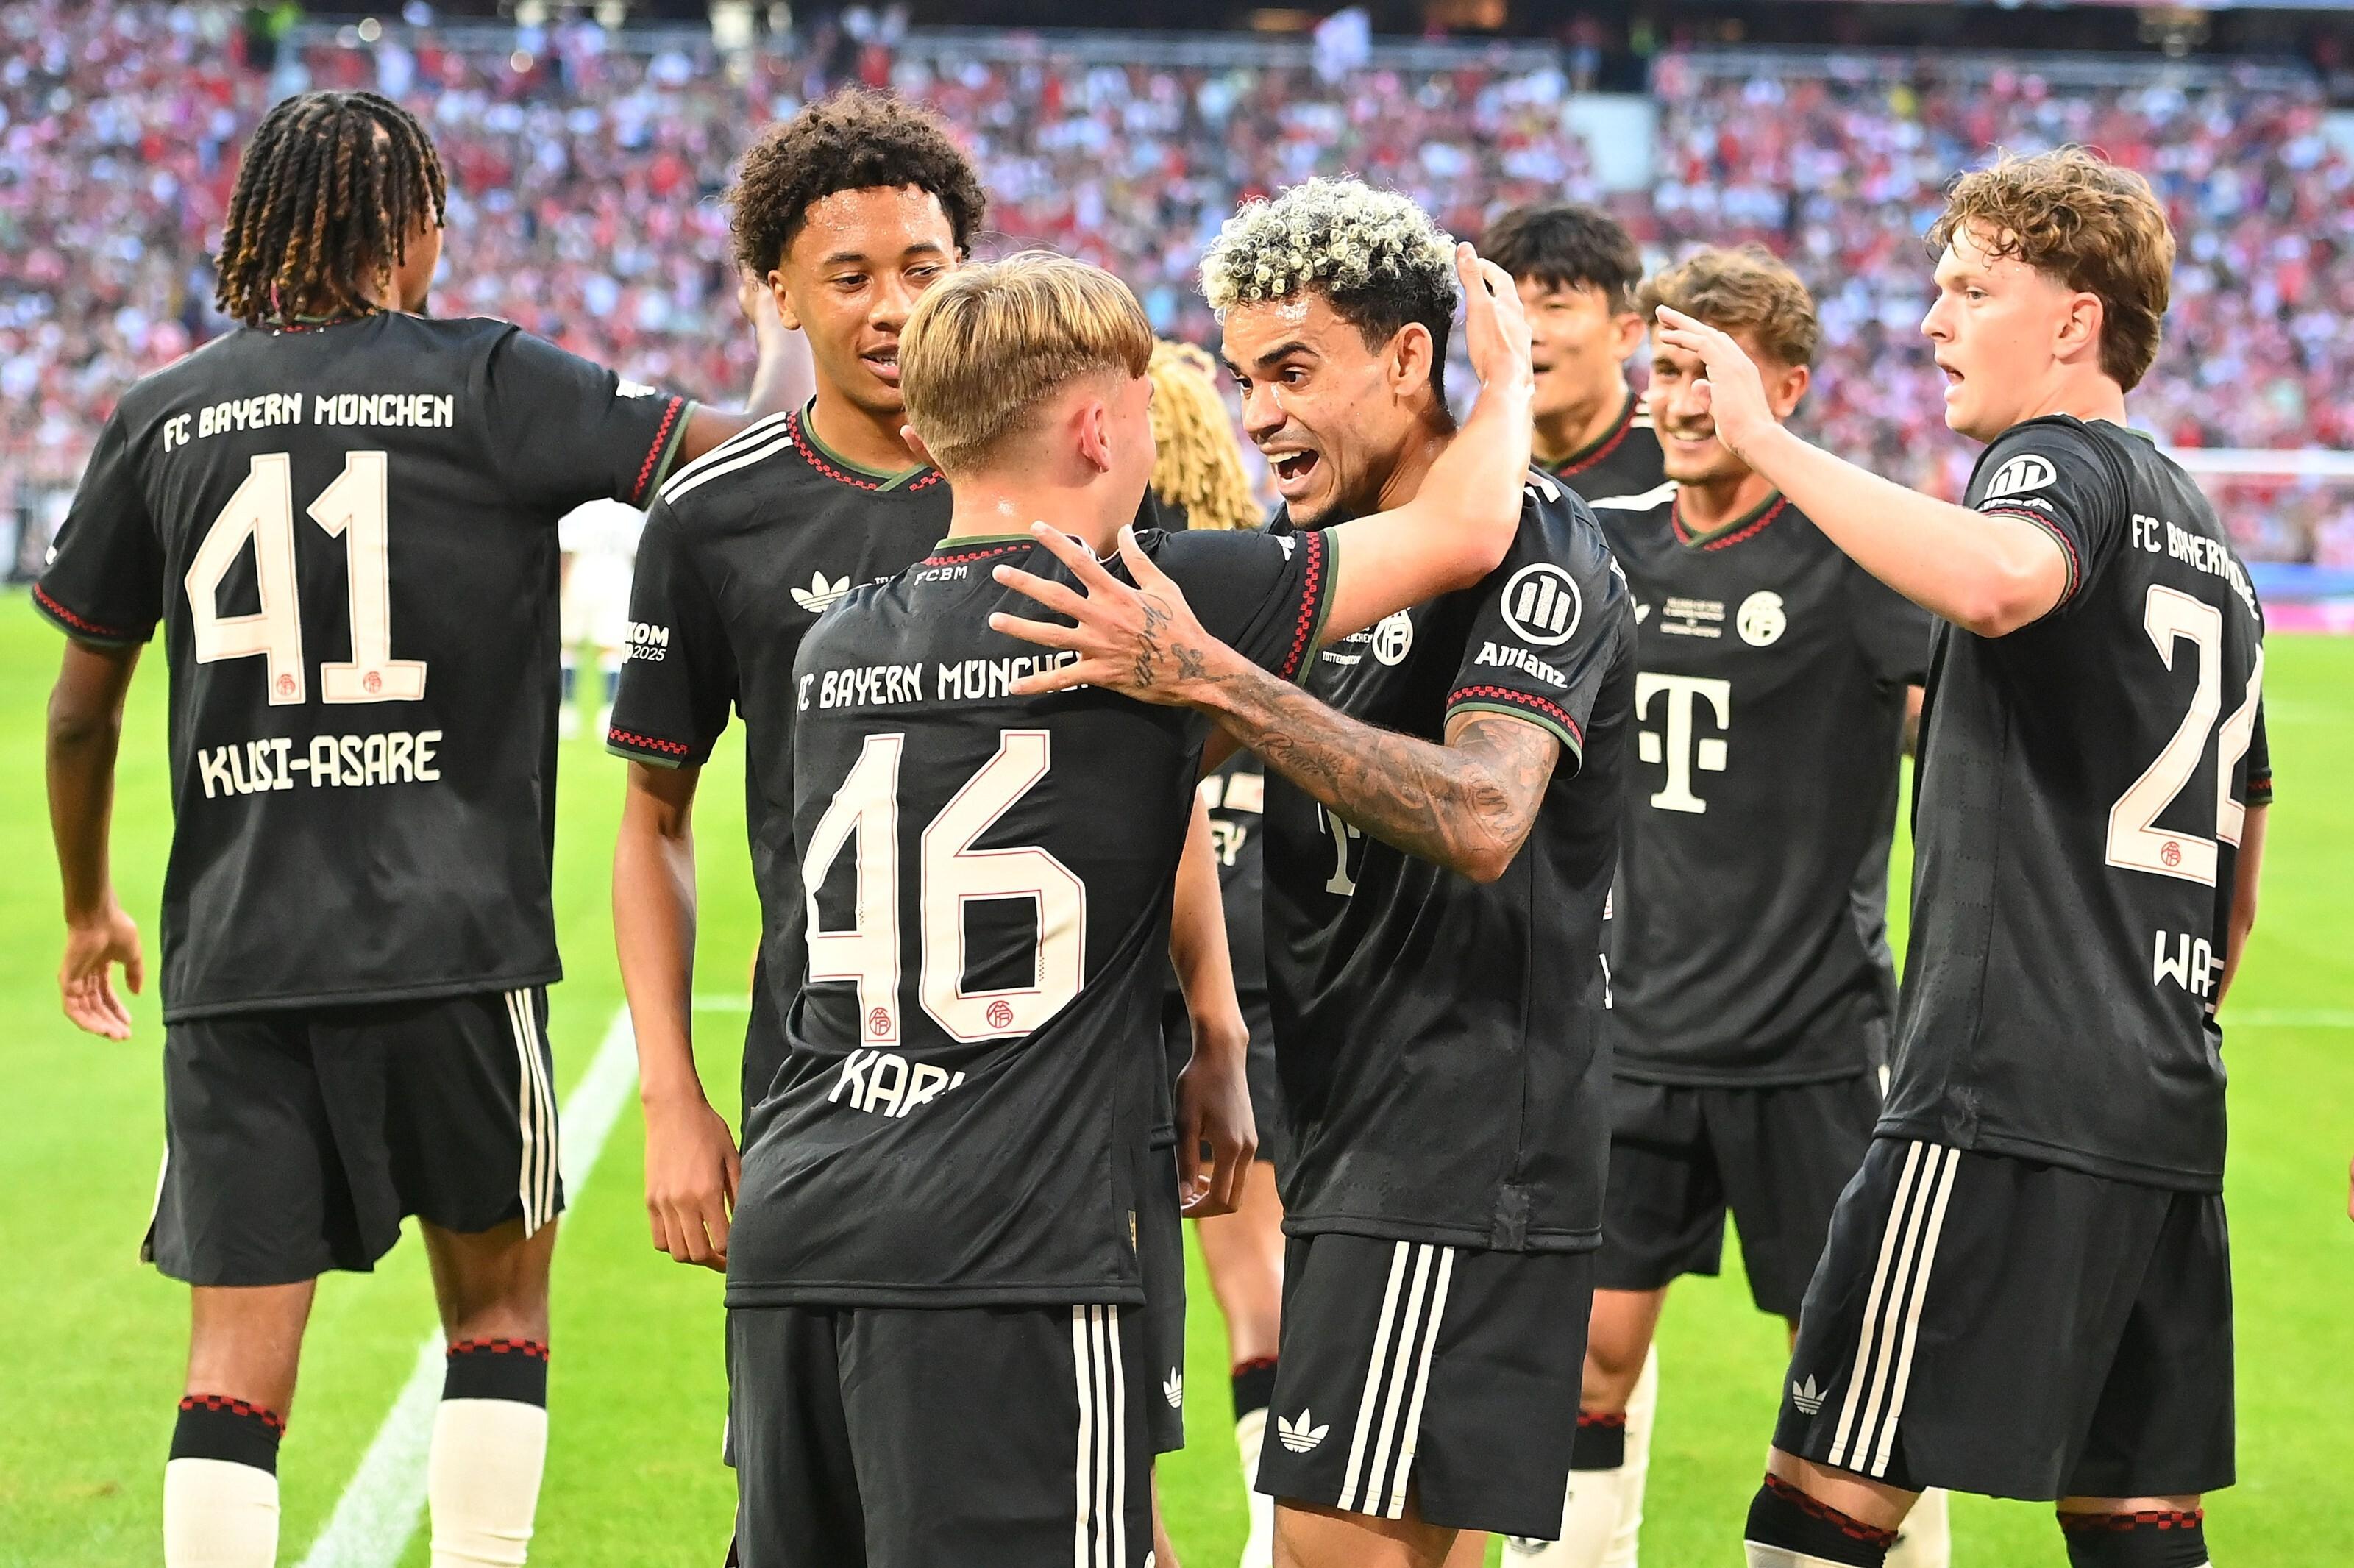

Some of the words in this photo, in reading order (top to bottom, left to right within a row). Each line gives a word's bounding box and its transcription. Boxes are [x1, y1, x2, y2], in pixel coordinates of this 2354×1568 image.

[163, 413, 191, 452] FC
[198, 392, 303, 438] BAYERN
[314, 393, 454, 428] MÜNCHEN
[185, 451, 427, 706] 41
[914, 566, 968, 586] FCBM
[2132, 513, 2162, 552] FC
[2166, 521, 2230, 580] BAYERN
[632, 645, 667, 662] 2025
[819, 663, 922, 709] BAYERN
[1474, 641, 1568, 688] Allianz
[198, 730, 444, 799] KUSI-ASARE
[1635, 671, 1731, 814] T
[801, 729, 1086, 1047] 46
[2153, 930, 2224, 998] WA
